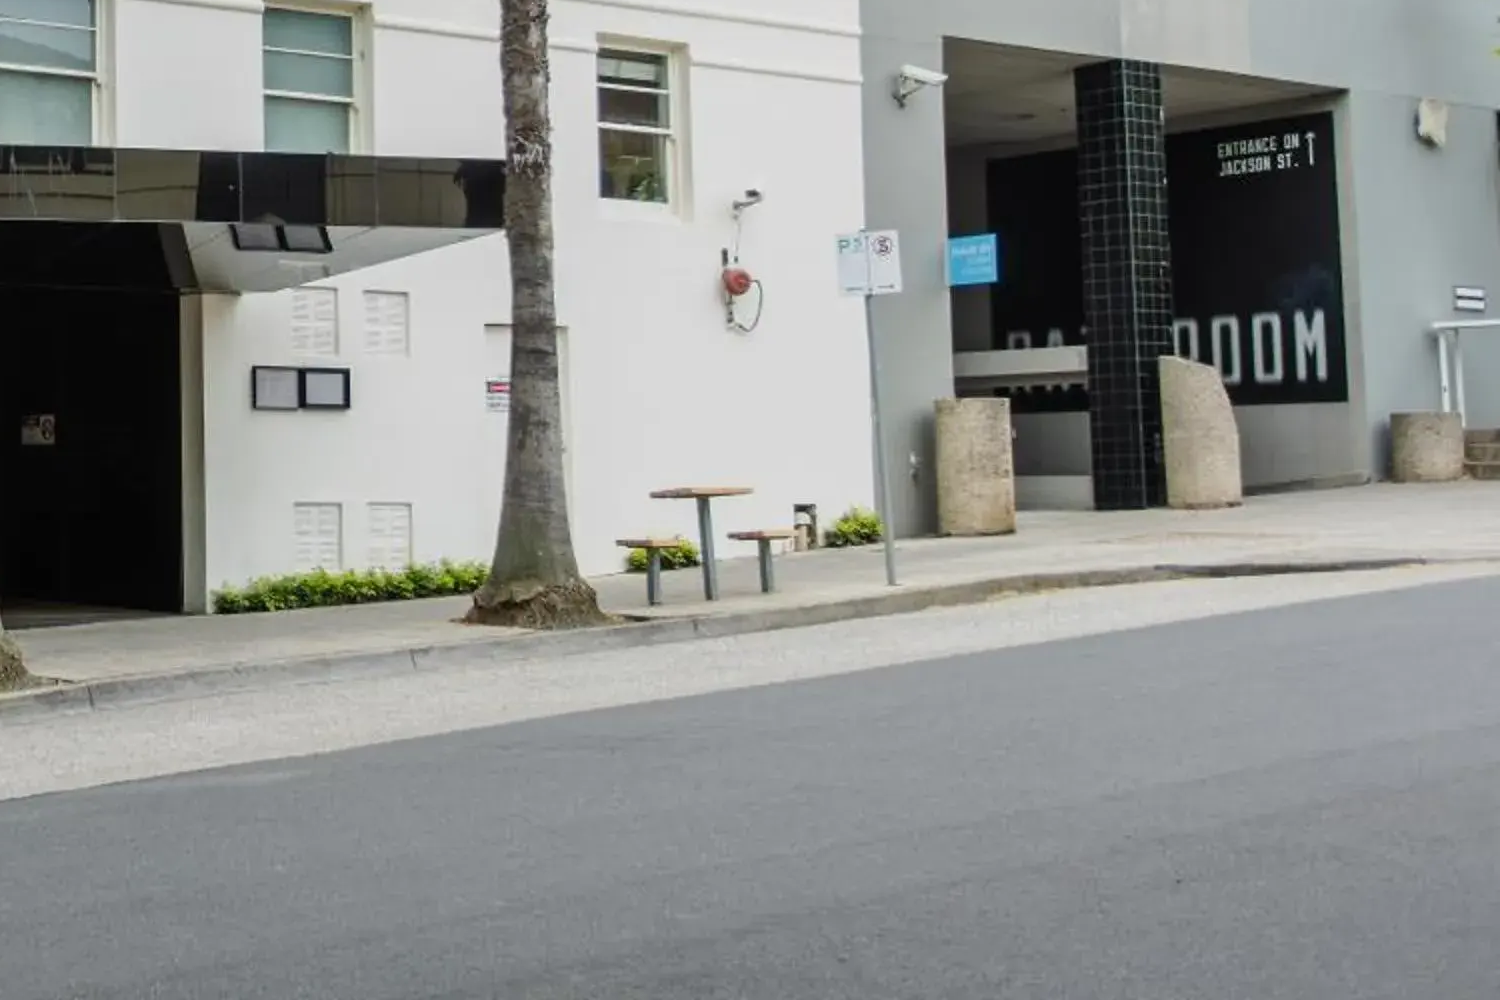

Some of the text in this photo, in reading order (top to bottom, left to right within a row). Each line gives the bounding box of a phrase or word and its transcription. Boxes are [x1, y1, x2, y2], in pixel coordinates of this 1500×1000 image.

[1217, 133, 1299, 159] ENTRANCE ON
[1219, 152, 1299, 176] JACKSON ST.
